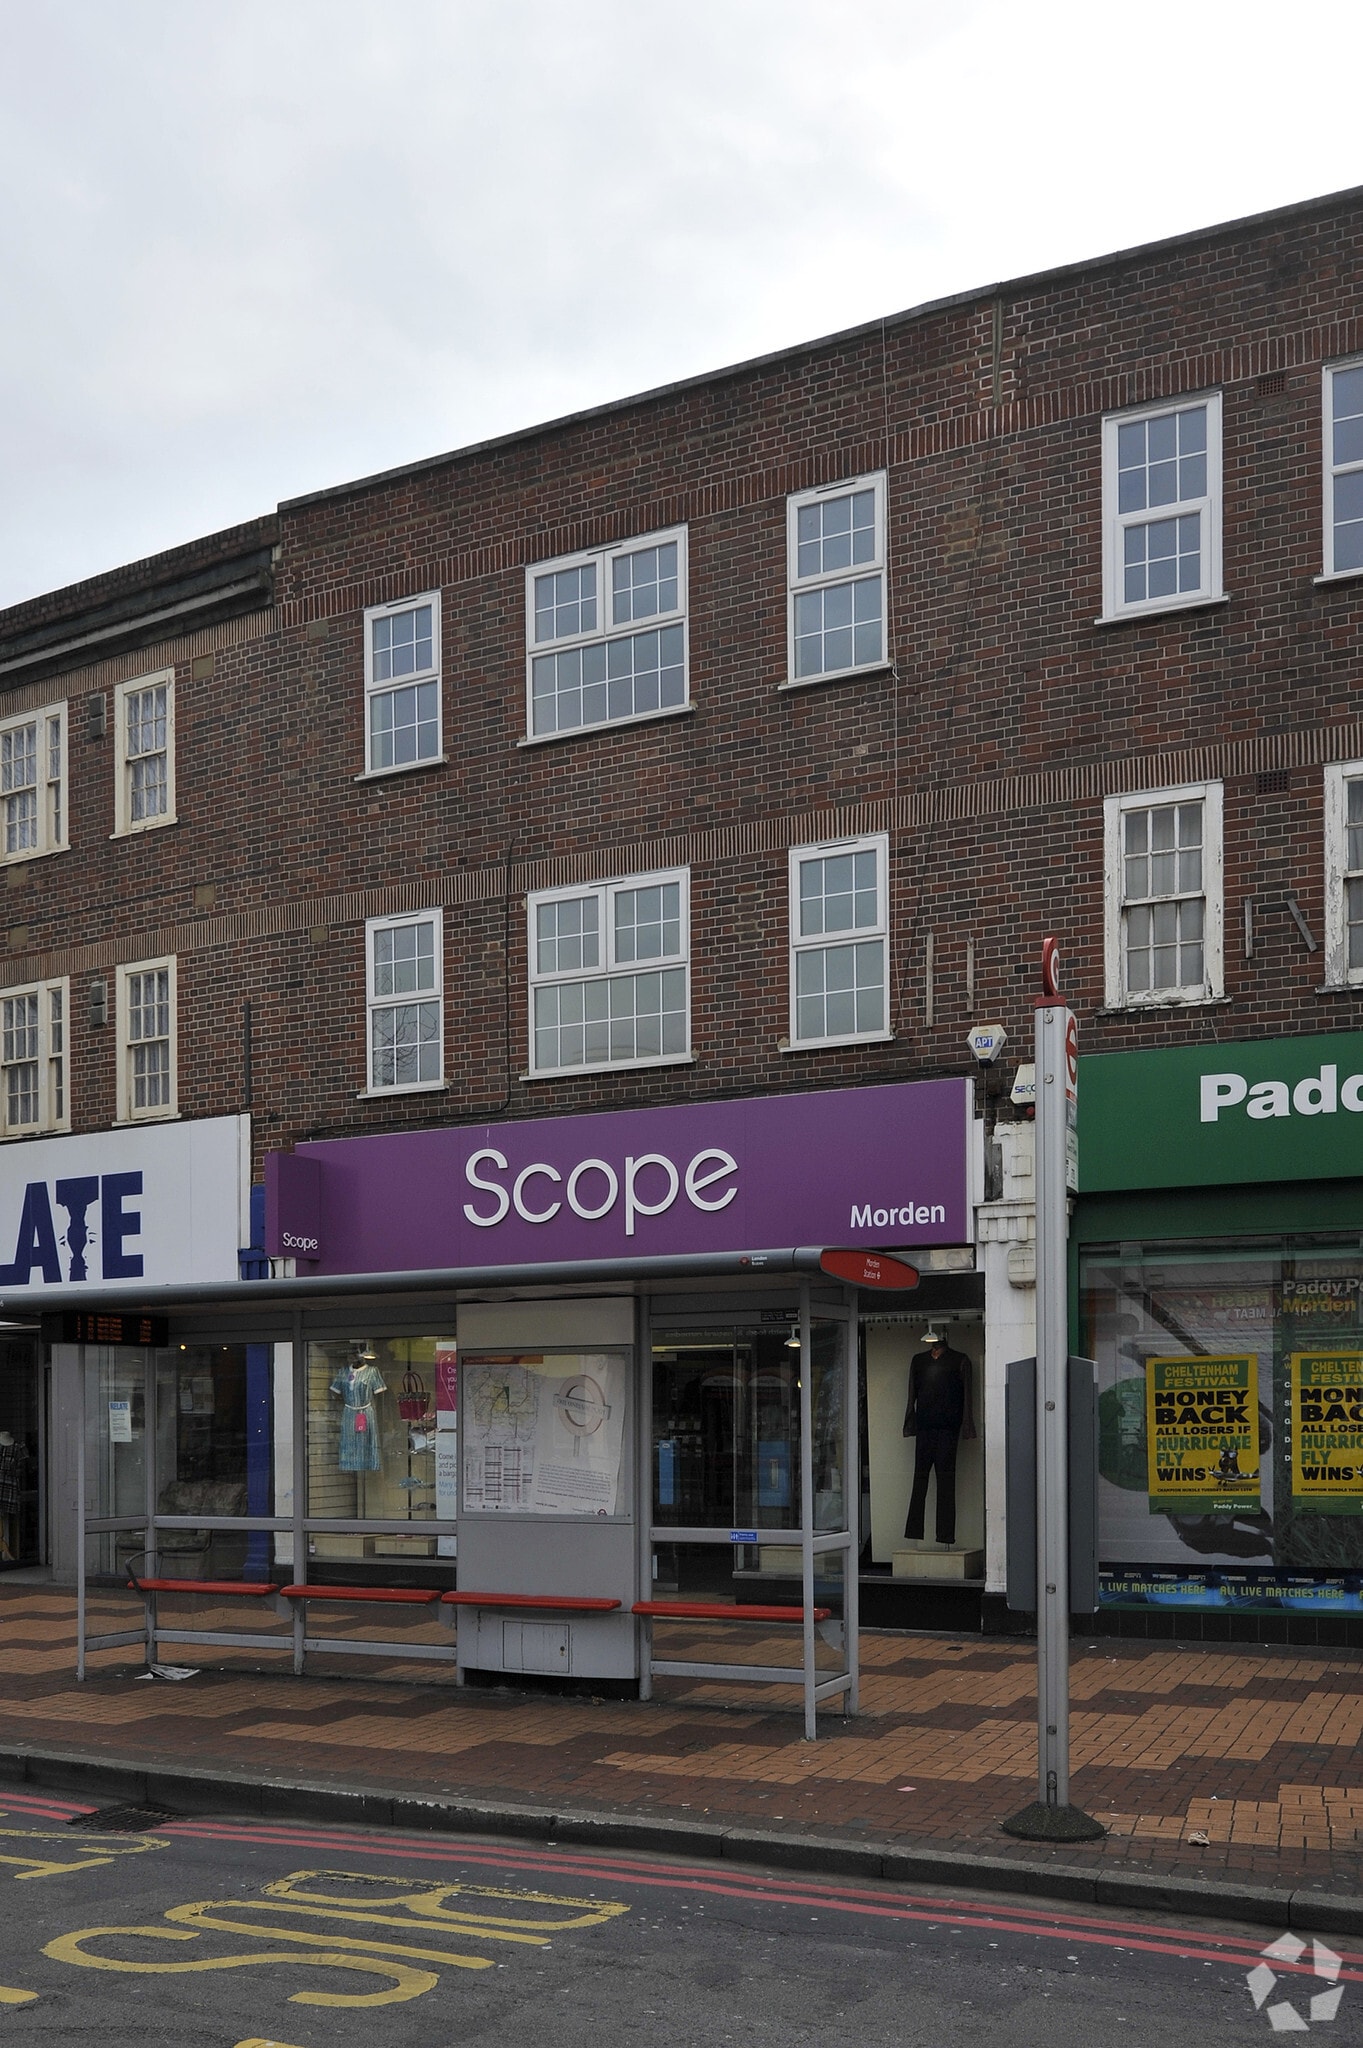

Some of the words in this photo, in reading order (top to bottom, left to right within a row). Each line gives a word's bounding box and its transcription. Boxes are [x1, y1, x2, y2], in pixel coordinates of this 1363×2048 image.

[976, 1037, 992, 1048] APT
[463, 1148, 738, 1236] Scope
[850, 1202, 946, 1229] Morden
[283, 1232, 318, 1251] Scope
[866, 1258, 880, 1269] Morden
[863, 1269, 876, 1279] Station
[1283, 1279, 1342, 1296] Paddy
[1283, 1297, 1357, 1313] Morden
[1165, 1364, 1239, 1377] CHELTENHAM
[1165, 1377, 1239, 1387] FESTIVAL
[1155, 1390, 1249, 1407] MONEY
[1301, 1388, 1363, 1403] MON
[1155, 1406, 1249, 1425] BACK
[1156, 1427, 1180, 1436] ALL
[1184, 1426, 1235, 1435] LOSERS
[1239, 1426, 1251, 1434] IF
[1301, 1425, 1326, 1433] ALL
[1156, 1436, 1251, 1451] HURRICANE
[1156, 1452, 1185, 1466] FLY
[1301, 1450, 1331, 1465] FLY
[1157, 1468, 1206, 1481] WINS
[1301, 1467, 1353, 1481] WINS
[1108, 1583, 1128, 1592] LIVE
[1132, 1583, 1177, 1594] MATCHES
[1181, 1585, 1206, 1595] HERE
[1220, 1586, 1237, 1596] ALL
[1240, 1586, 1262, 1596] LIVE
[1265, 1587, 1314, 1598] MATCHES
[1317, 1589, 1345, 1599] HERE
